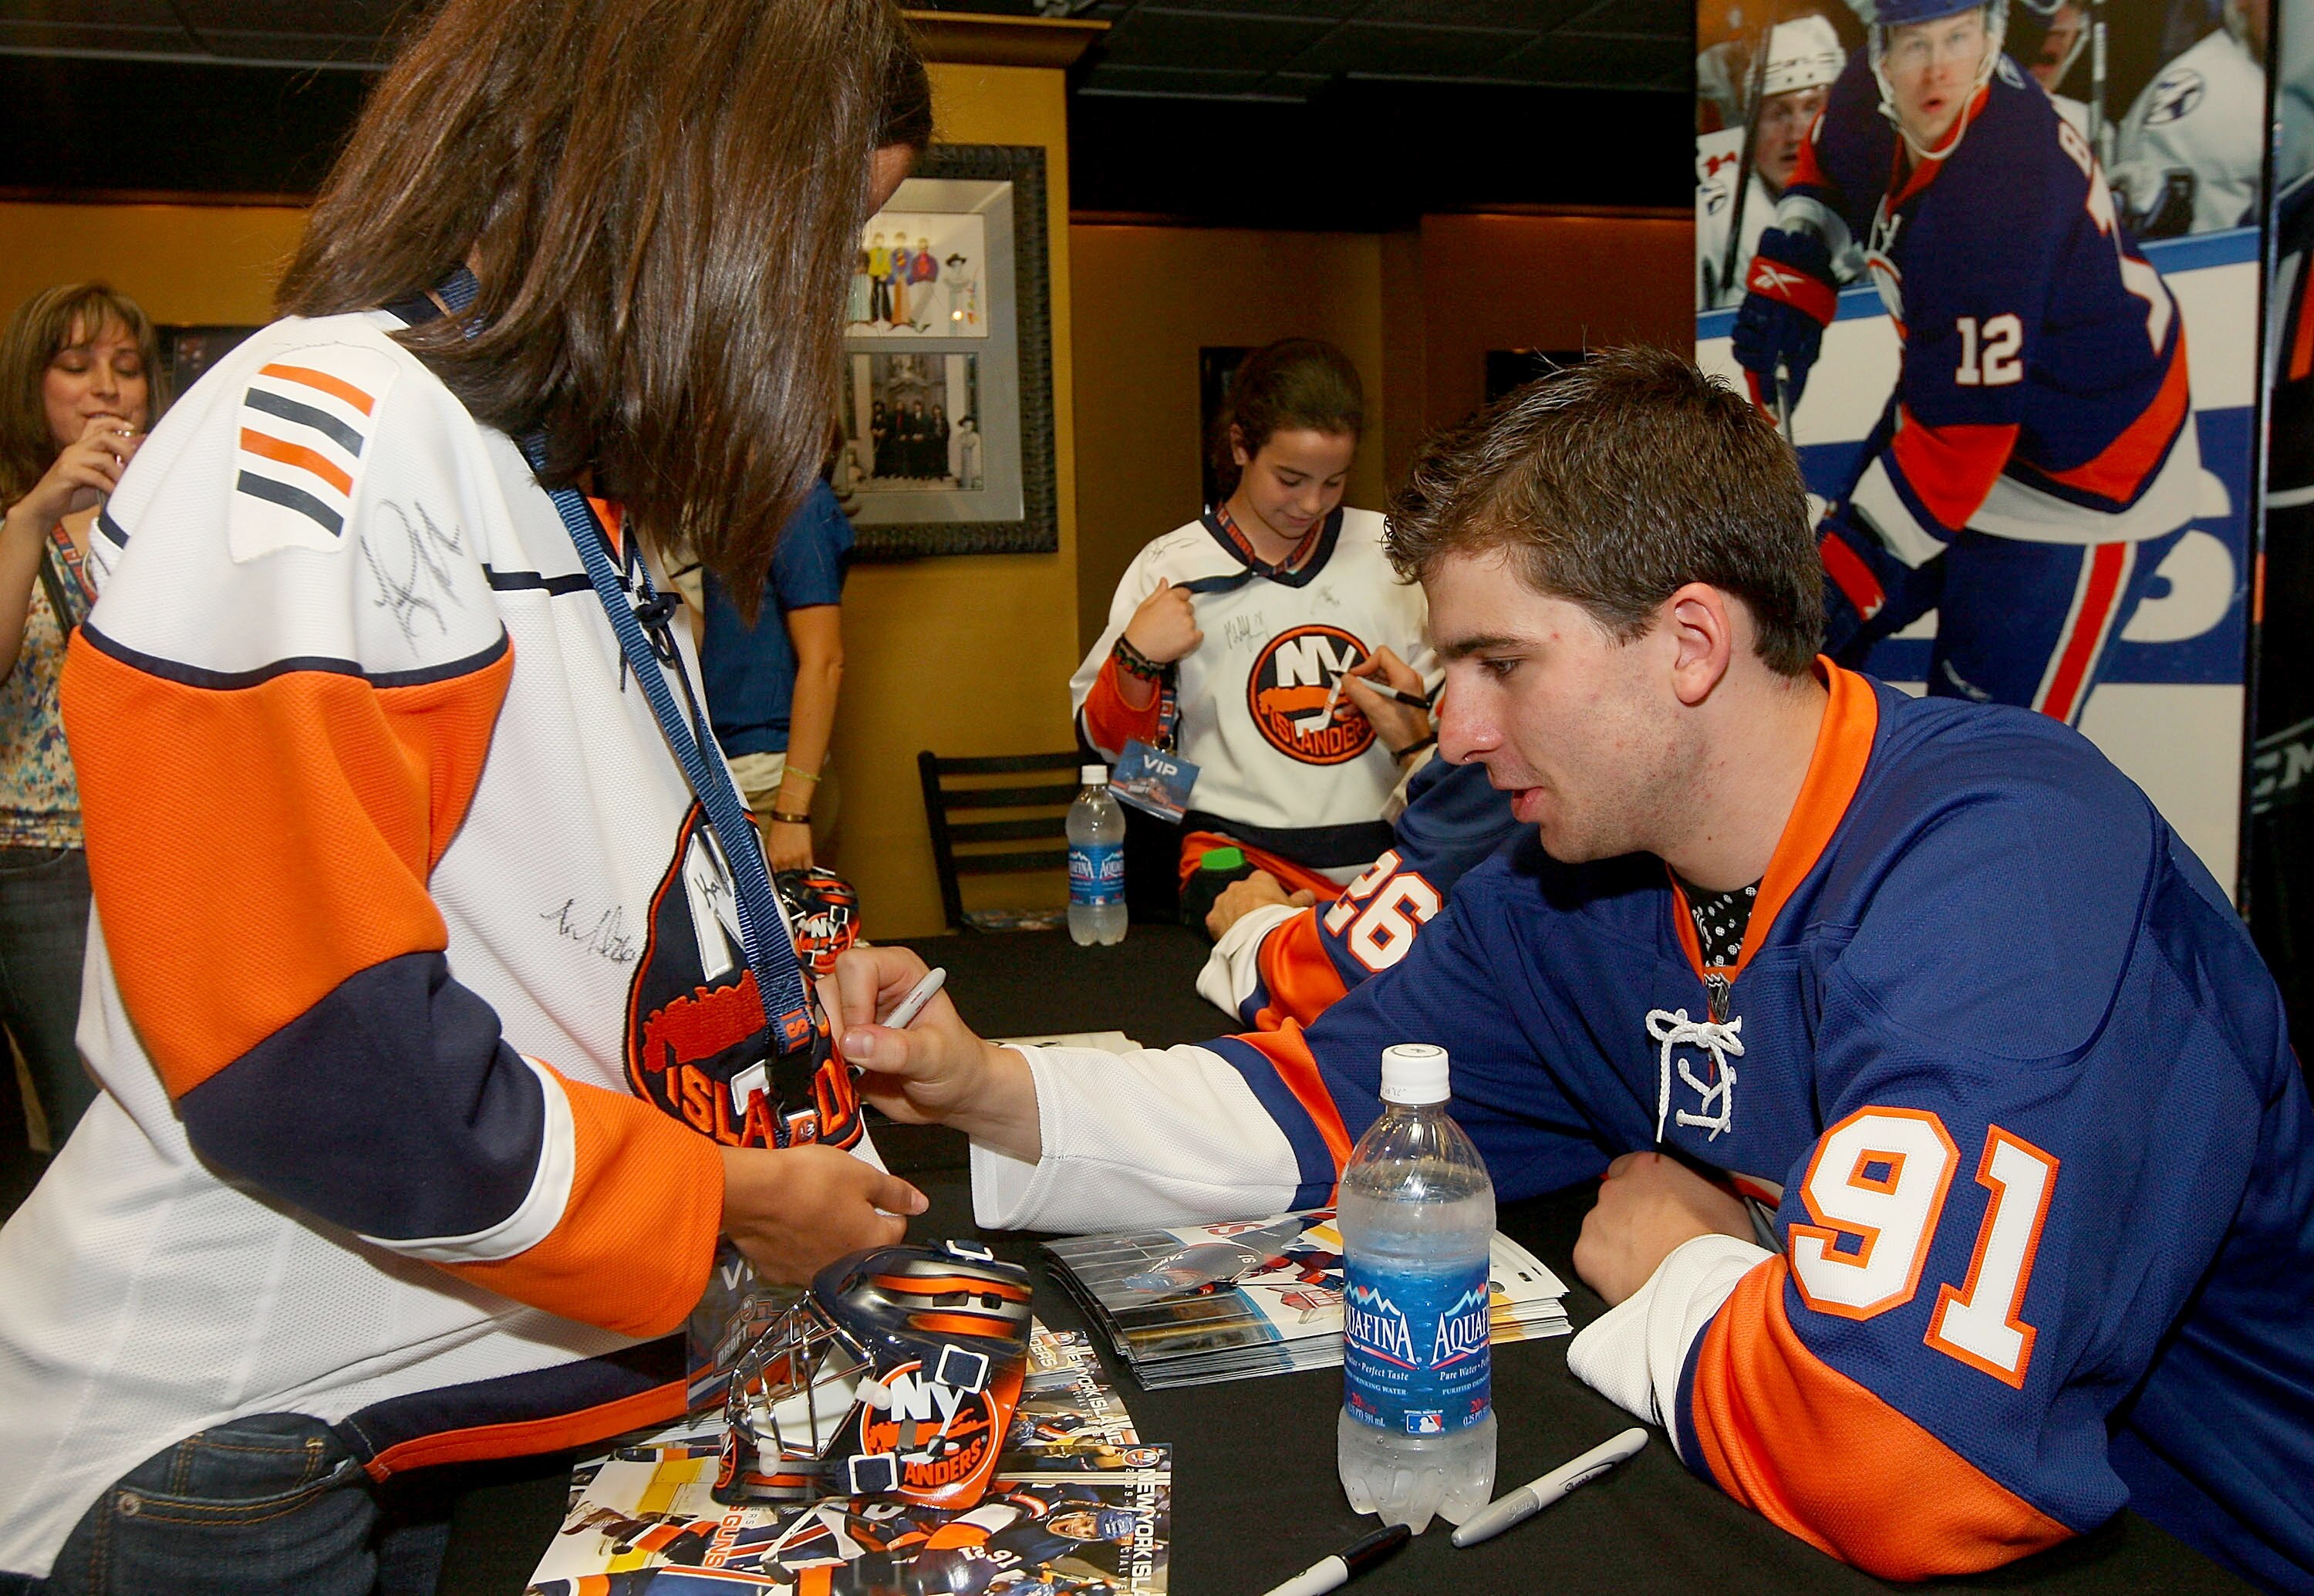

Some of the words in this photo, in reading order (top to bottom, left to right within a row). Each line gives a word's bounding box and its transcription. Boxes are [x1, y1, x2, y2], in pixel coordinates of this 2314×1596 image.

[1955, 312, 2022, 386] 12
[1275, 636, 1357, 688] NY
[1267, 702, 1369, 755] ISLANDER
[1143, 754, 1179, 776] VIP
[1788, 1105, 2061, 1390] 91
[1361, 1361, 1385, 1378] Perfect
[1387, 1368, 1409, 1382] Taste
[1381, 1385, 1407, 1395] WATER
[1439, 1371, 1457, 1382] Pure
[1459, 1365, 1478, 1378] Water
[1442, 1383, 1472, 1395] PURIFIED
[903, 1438, 983, 1486] ANDERS
[703, 1514, 743, 1567] GUNS
[1132, 1510, 1155, 1560] YORK
